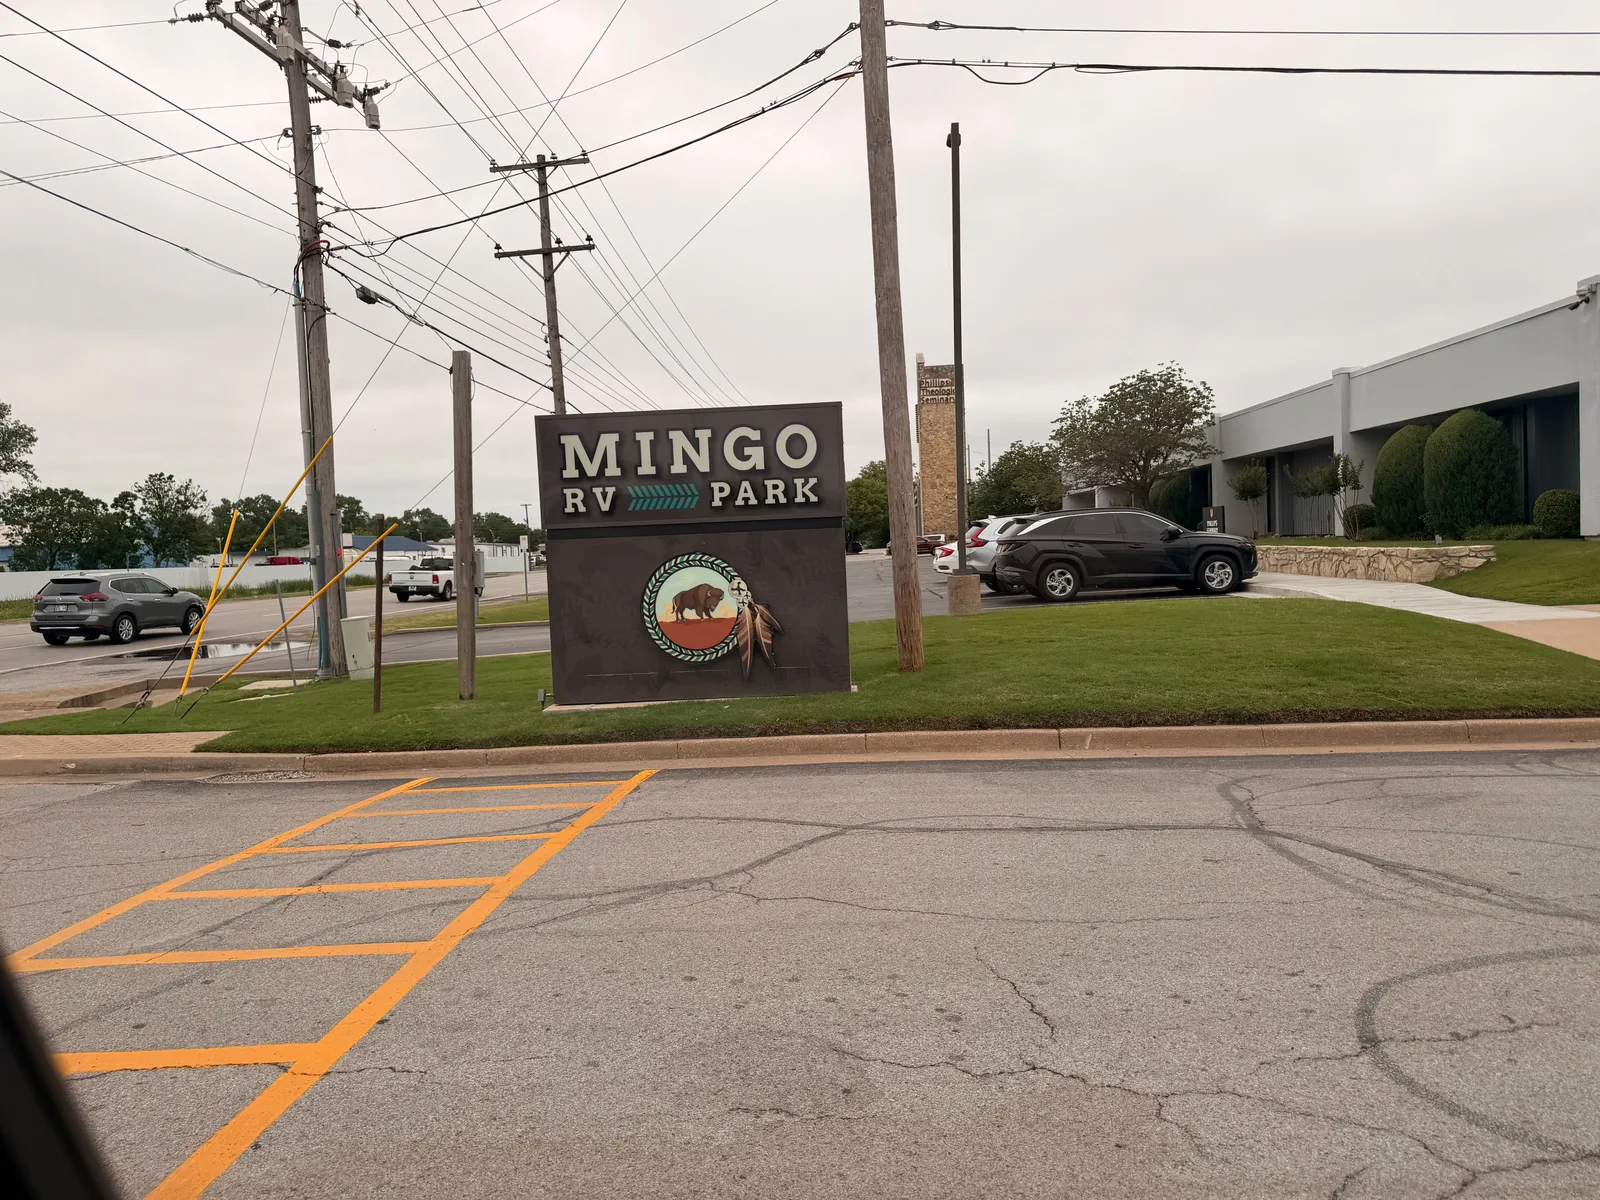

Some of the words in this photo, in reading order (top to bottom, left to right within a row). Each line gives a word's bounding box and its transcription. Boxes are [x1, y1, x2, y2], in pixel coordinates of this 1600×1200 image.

[920, 378, 952, 387] Phillips
[560, 424, 817, 478] MINGO
[563, 486, 616, 513] RV
[710, 478, 819, 507] PARK
